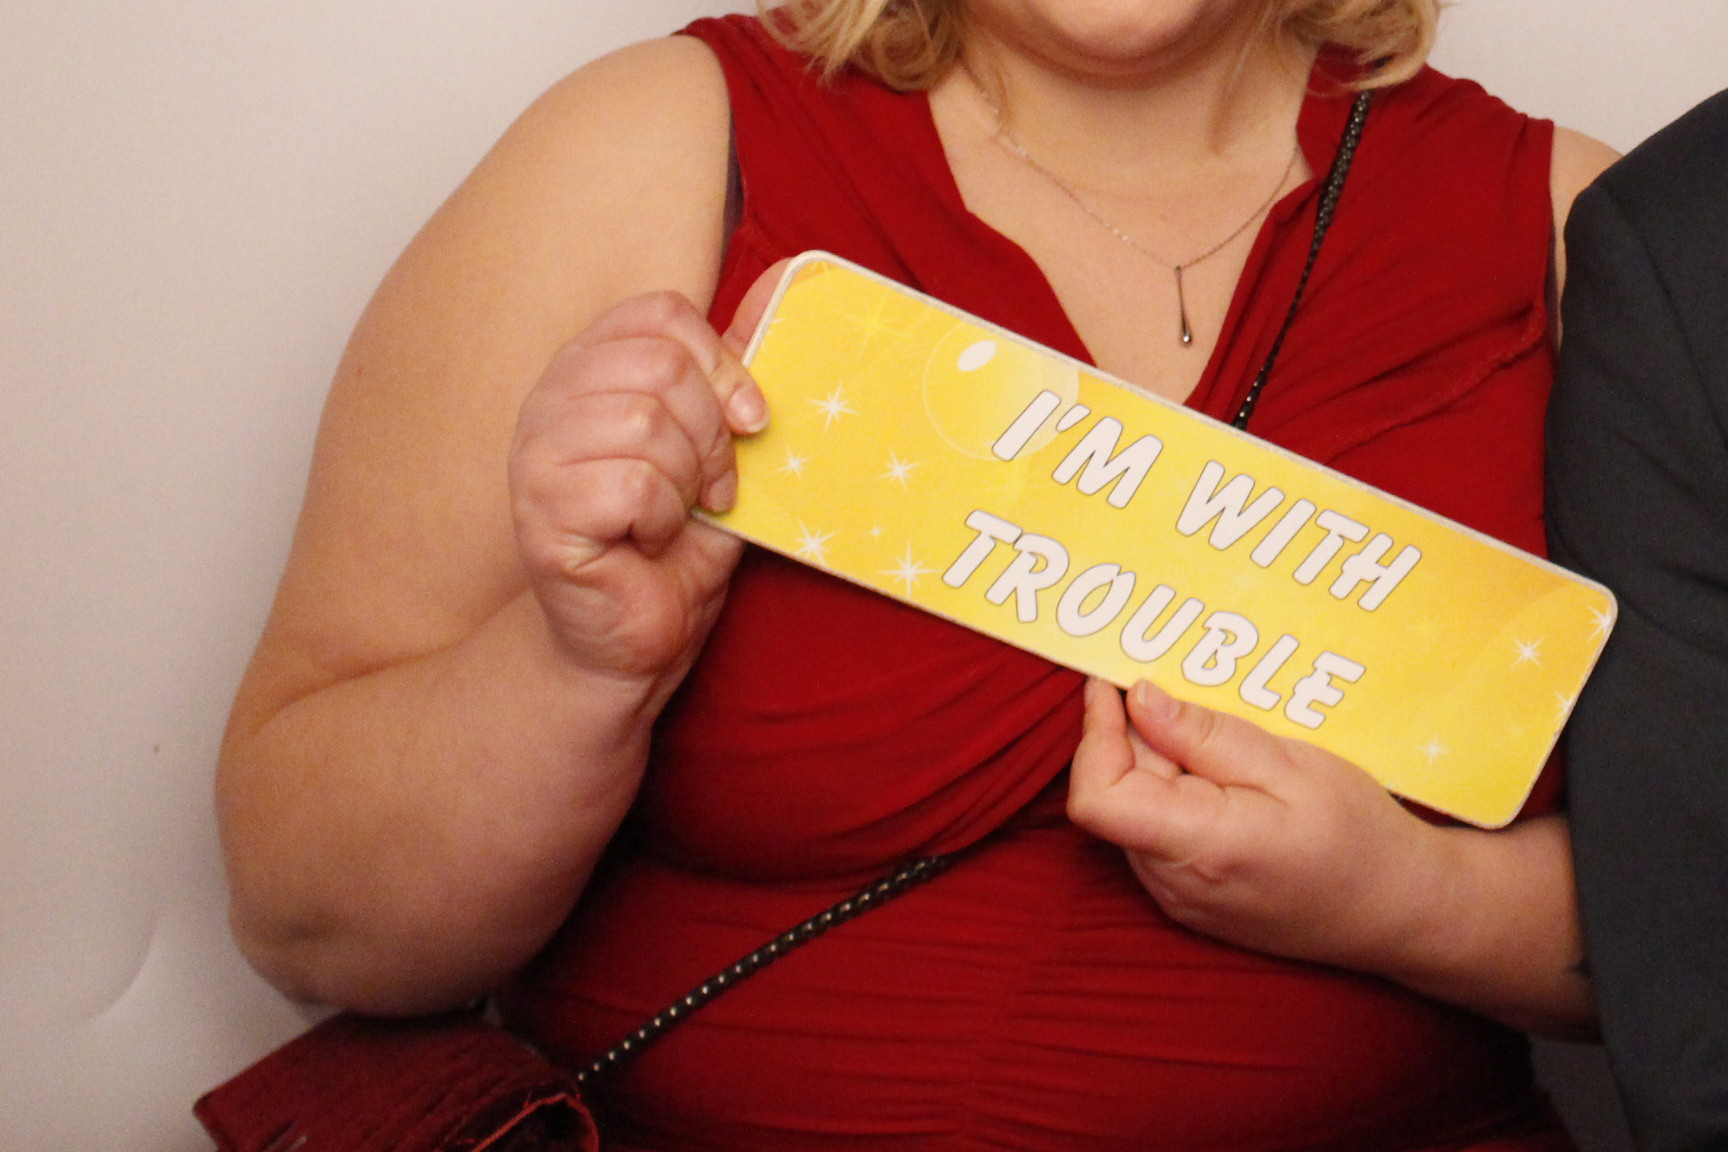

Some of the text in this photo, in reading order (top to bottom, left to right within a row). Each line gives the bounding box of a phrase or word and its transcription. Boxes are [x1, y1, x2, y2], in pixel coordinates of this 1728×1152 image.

[991, 389, 1423, 612] I'M WITH
[941, 509, 1366, 731] TROUBLE
